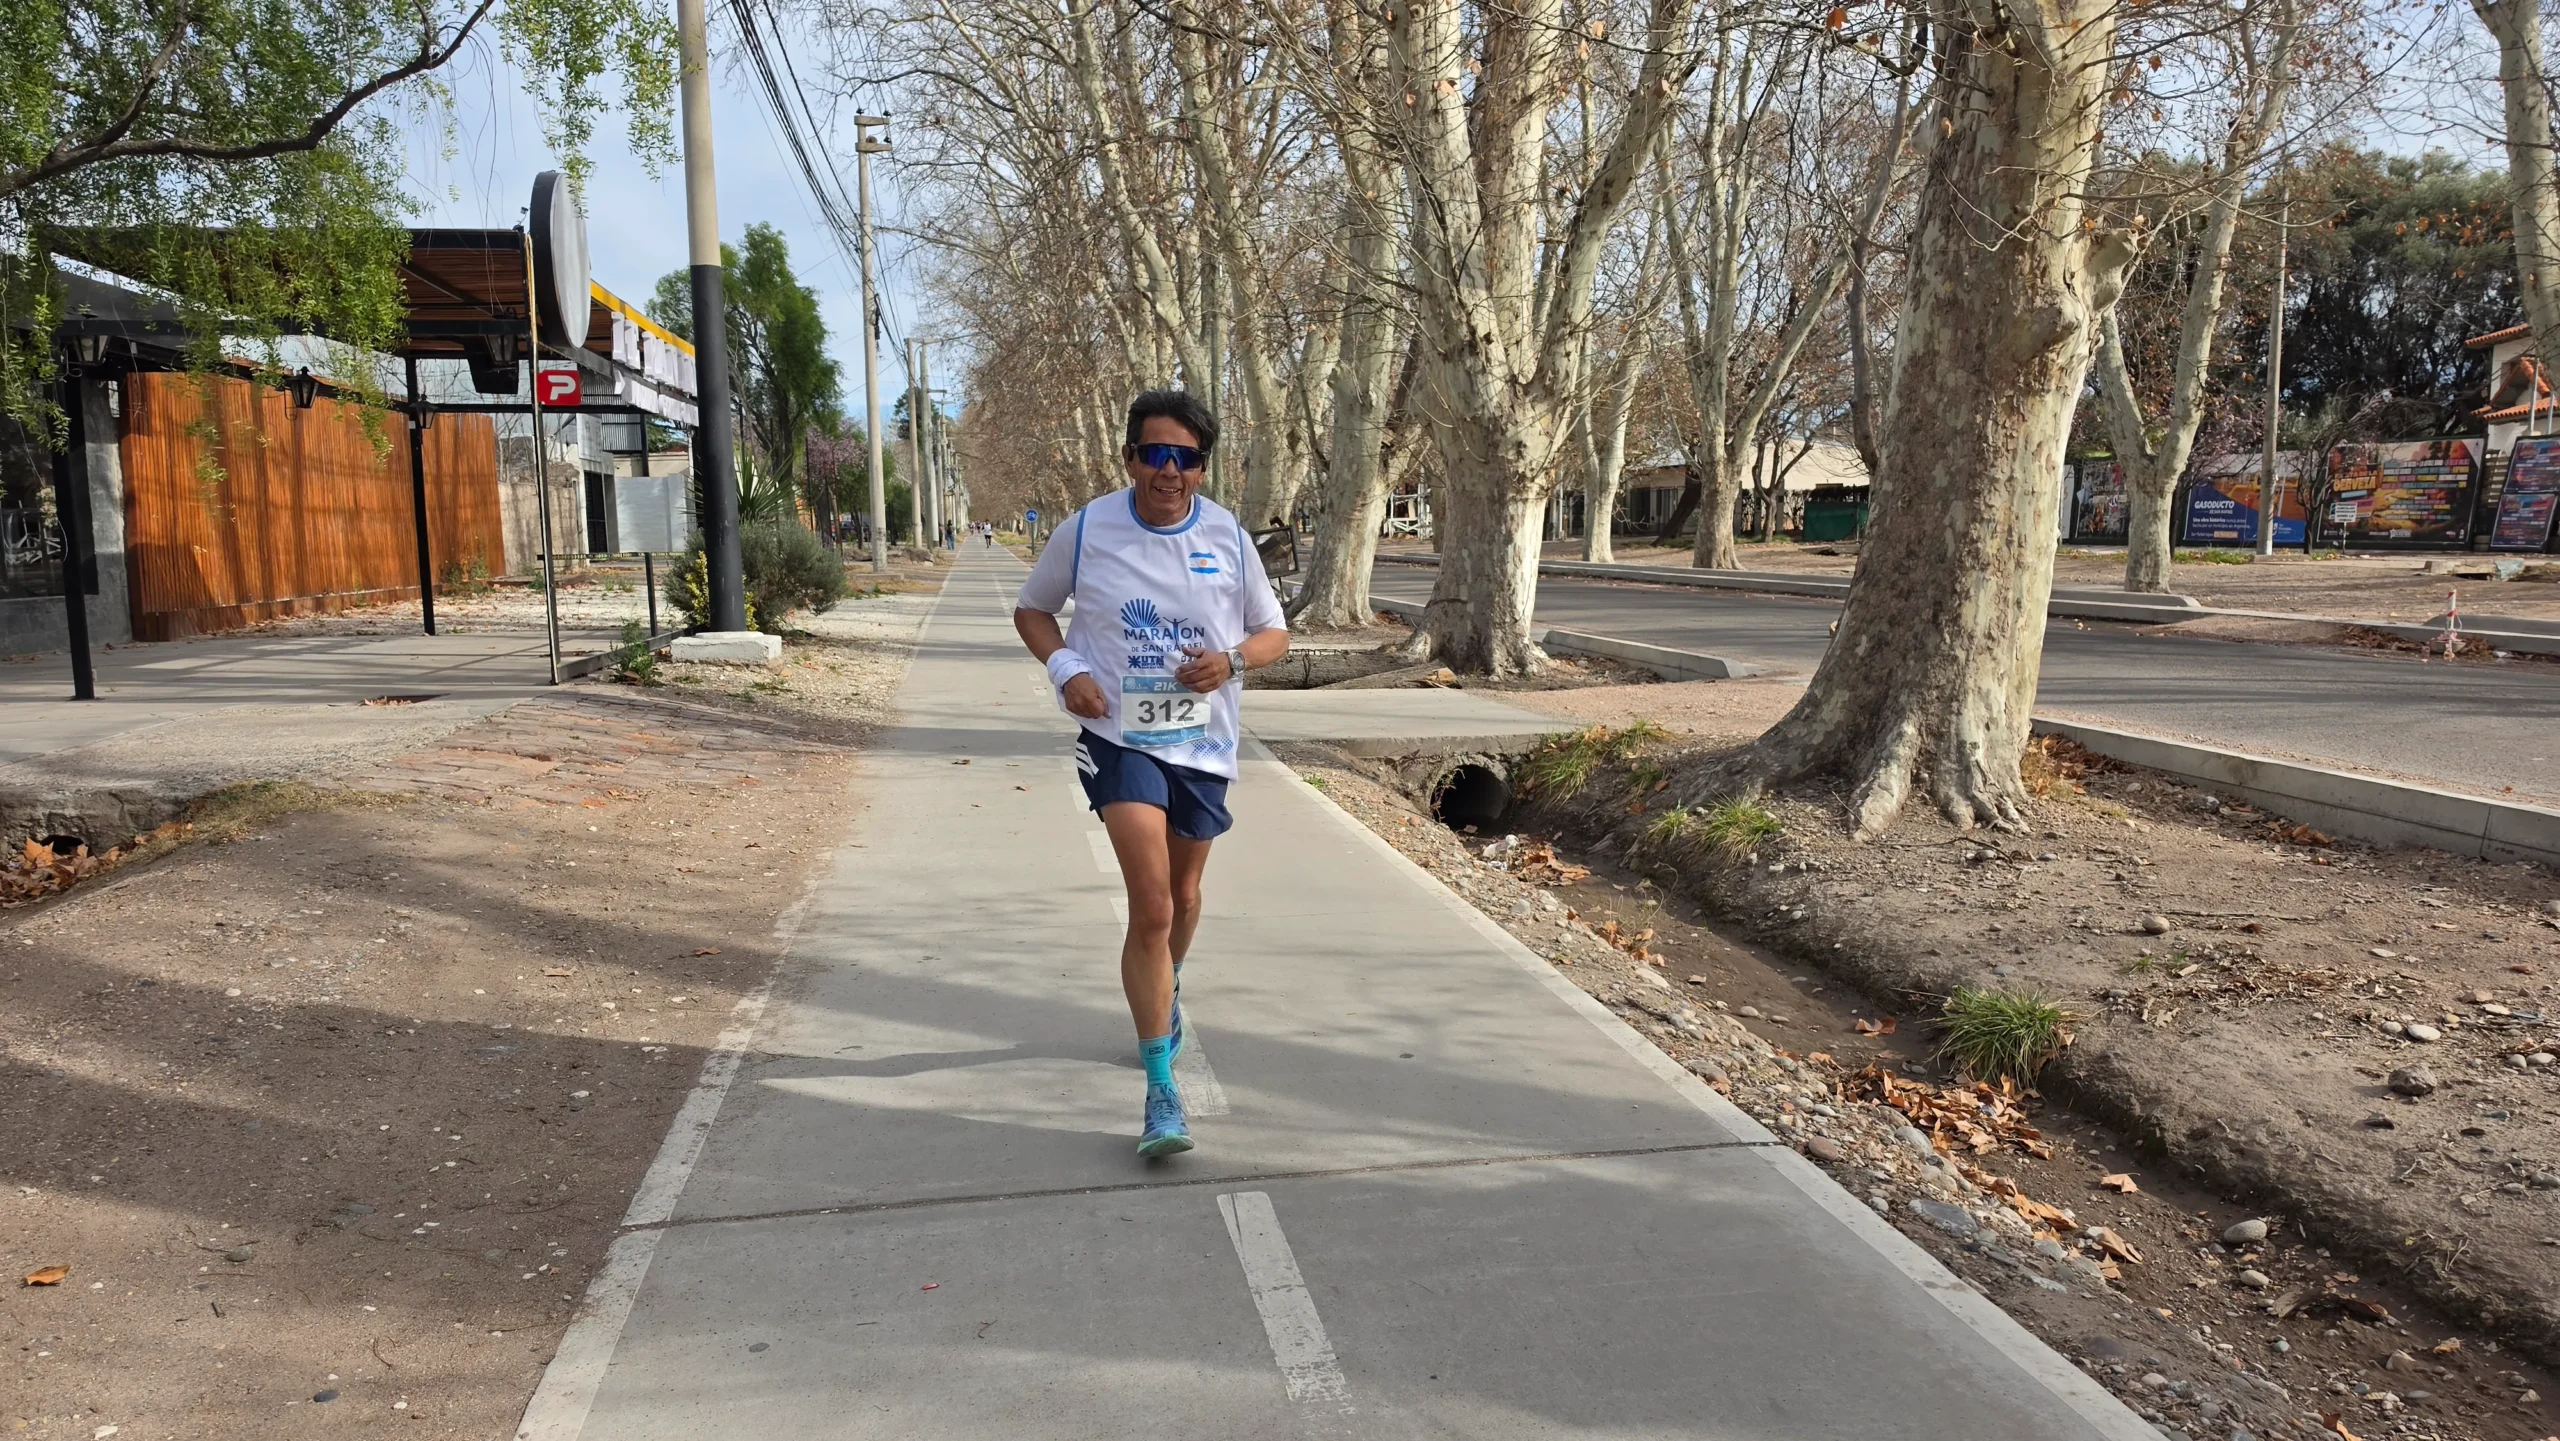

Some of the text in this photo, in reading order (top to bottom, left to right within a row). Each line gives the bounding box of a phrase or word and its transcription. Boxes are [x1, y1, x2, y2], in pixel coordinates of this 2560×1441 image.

[547, 375, 576, 400] P
[2333, 476, 2376, 492] CERVEZA
[2194, 500, 2235, 509] GASODUCTO
[1141, 644, 1164, 653] SAN
[1141, 655, 1165, 665] UTN
[1153, 681, 1178, 691] 21K
[1137, 698, 1195, 724] 312
